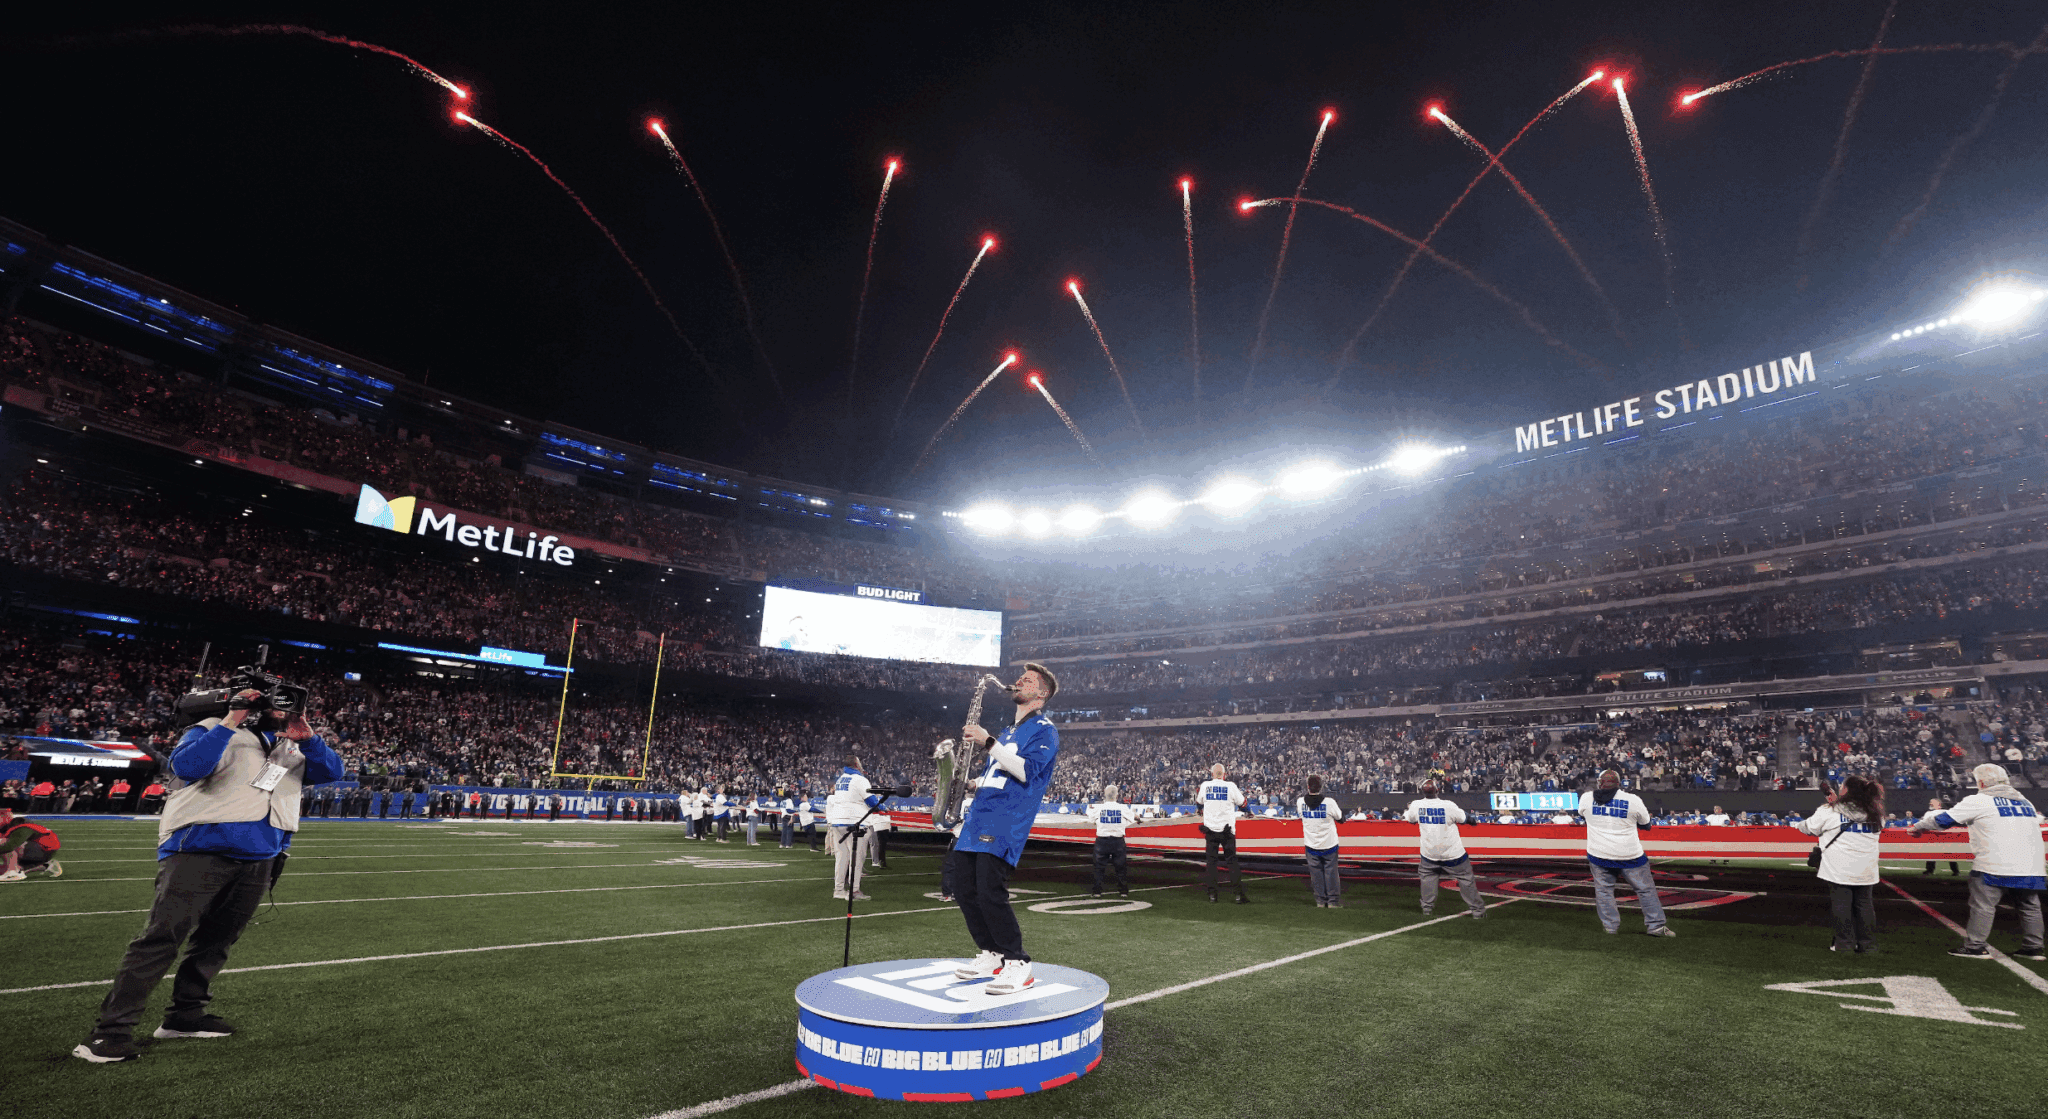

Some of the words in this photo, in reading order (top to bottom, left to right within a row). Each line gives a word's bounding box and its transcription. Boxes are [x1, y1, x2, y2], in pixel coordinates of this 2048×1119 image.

[1515, 397, 1644, 453] METLIFE
[1654, 351, 1816, 419] STADIUM
[417, 507, 575, 566] MetLife
[857, 586, 884, 597] BUD
[884, 589, 920, 602] LIGHT
[1604, 692, 1662, 702] METLIFE
[1667, 687, 1732, 698] STADIUM
[1206, 793, 1228, 801] BLUE
[1427, 808, 1446, 816] BIG
[1592, 807, 1629, 818] BLUE
[1419, 816, 1446, 824] BLUE
[822, 1036, 864, 1065] BLUE
[863, 1046, 881, 1067] GO
[881, 1048, 920, 1071] BIG
[922, 1050, 983, 1071] BLUE
[984, 1048, 1003, 1069] GO
[1003, 1043, 1040, 1067] BIG
[1040, 1032, 1080, 1062] BLUE
